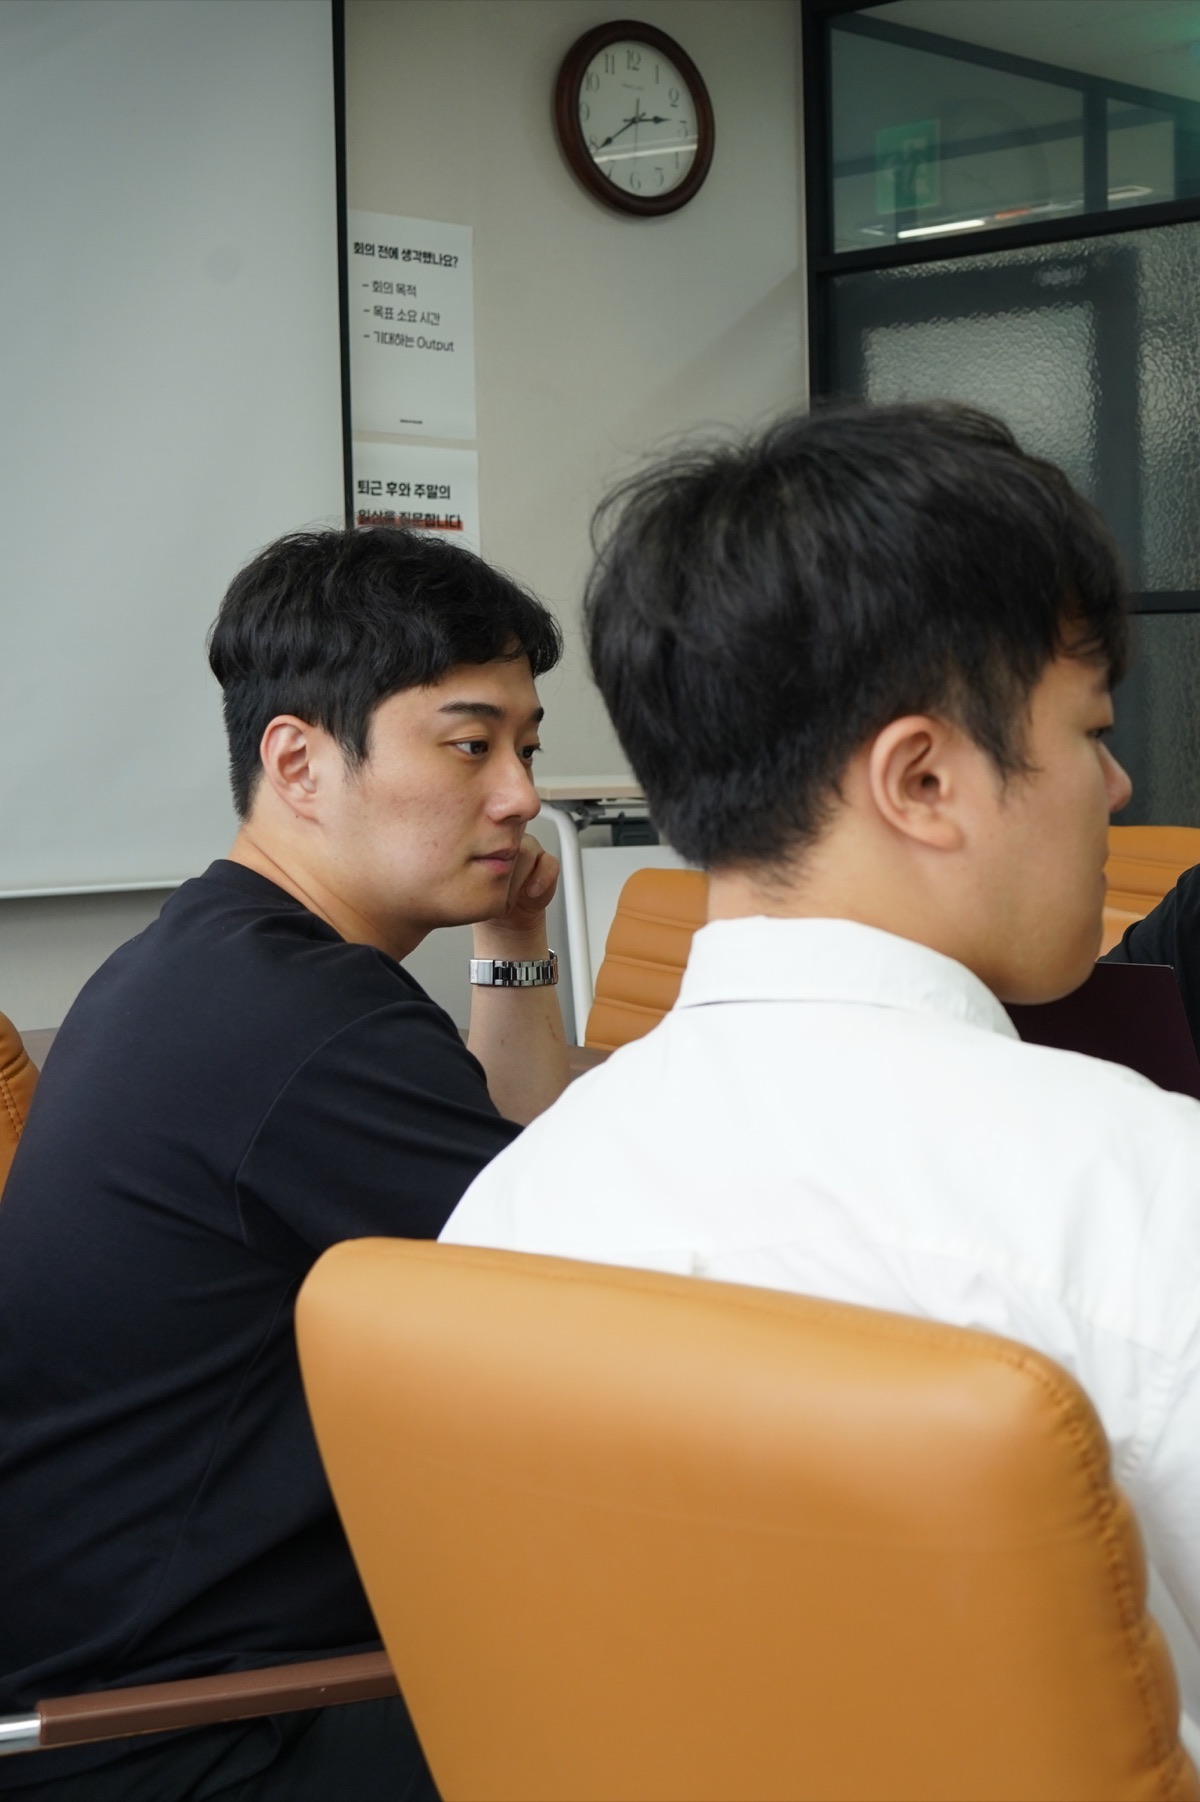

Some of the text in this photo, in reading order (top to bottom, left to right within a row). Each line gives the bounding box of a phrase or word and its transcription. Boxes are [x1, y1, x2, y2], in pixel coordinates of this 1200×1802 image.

[605, 53, 616, 75] 11
[626, 49, 641, 71] 12
[668, 88, 680, 108] 2
[353, 241, 459, 268] 회의 전에 생각했나요?
[372, 280, 393, 295] 회의
[395, 282, 417, 298] 목적
[373, 305, 394, 321] 목표
[396, 308, 417, 323] 소요
[420, 311, 441, 326] 시간
[373, 331, 415, 348] 기대하는
[416, 336, 455, 353] Output
[357, 480, 451, 500] 퇴근 후와 주말의
